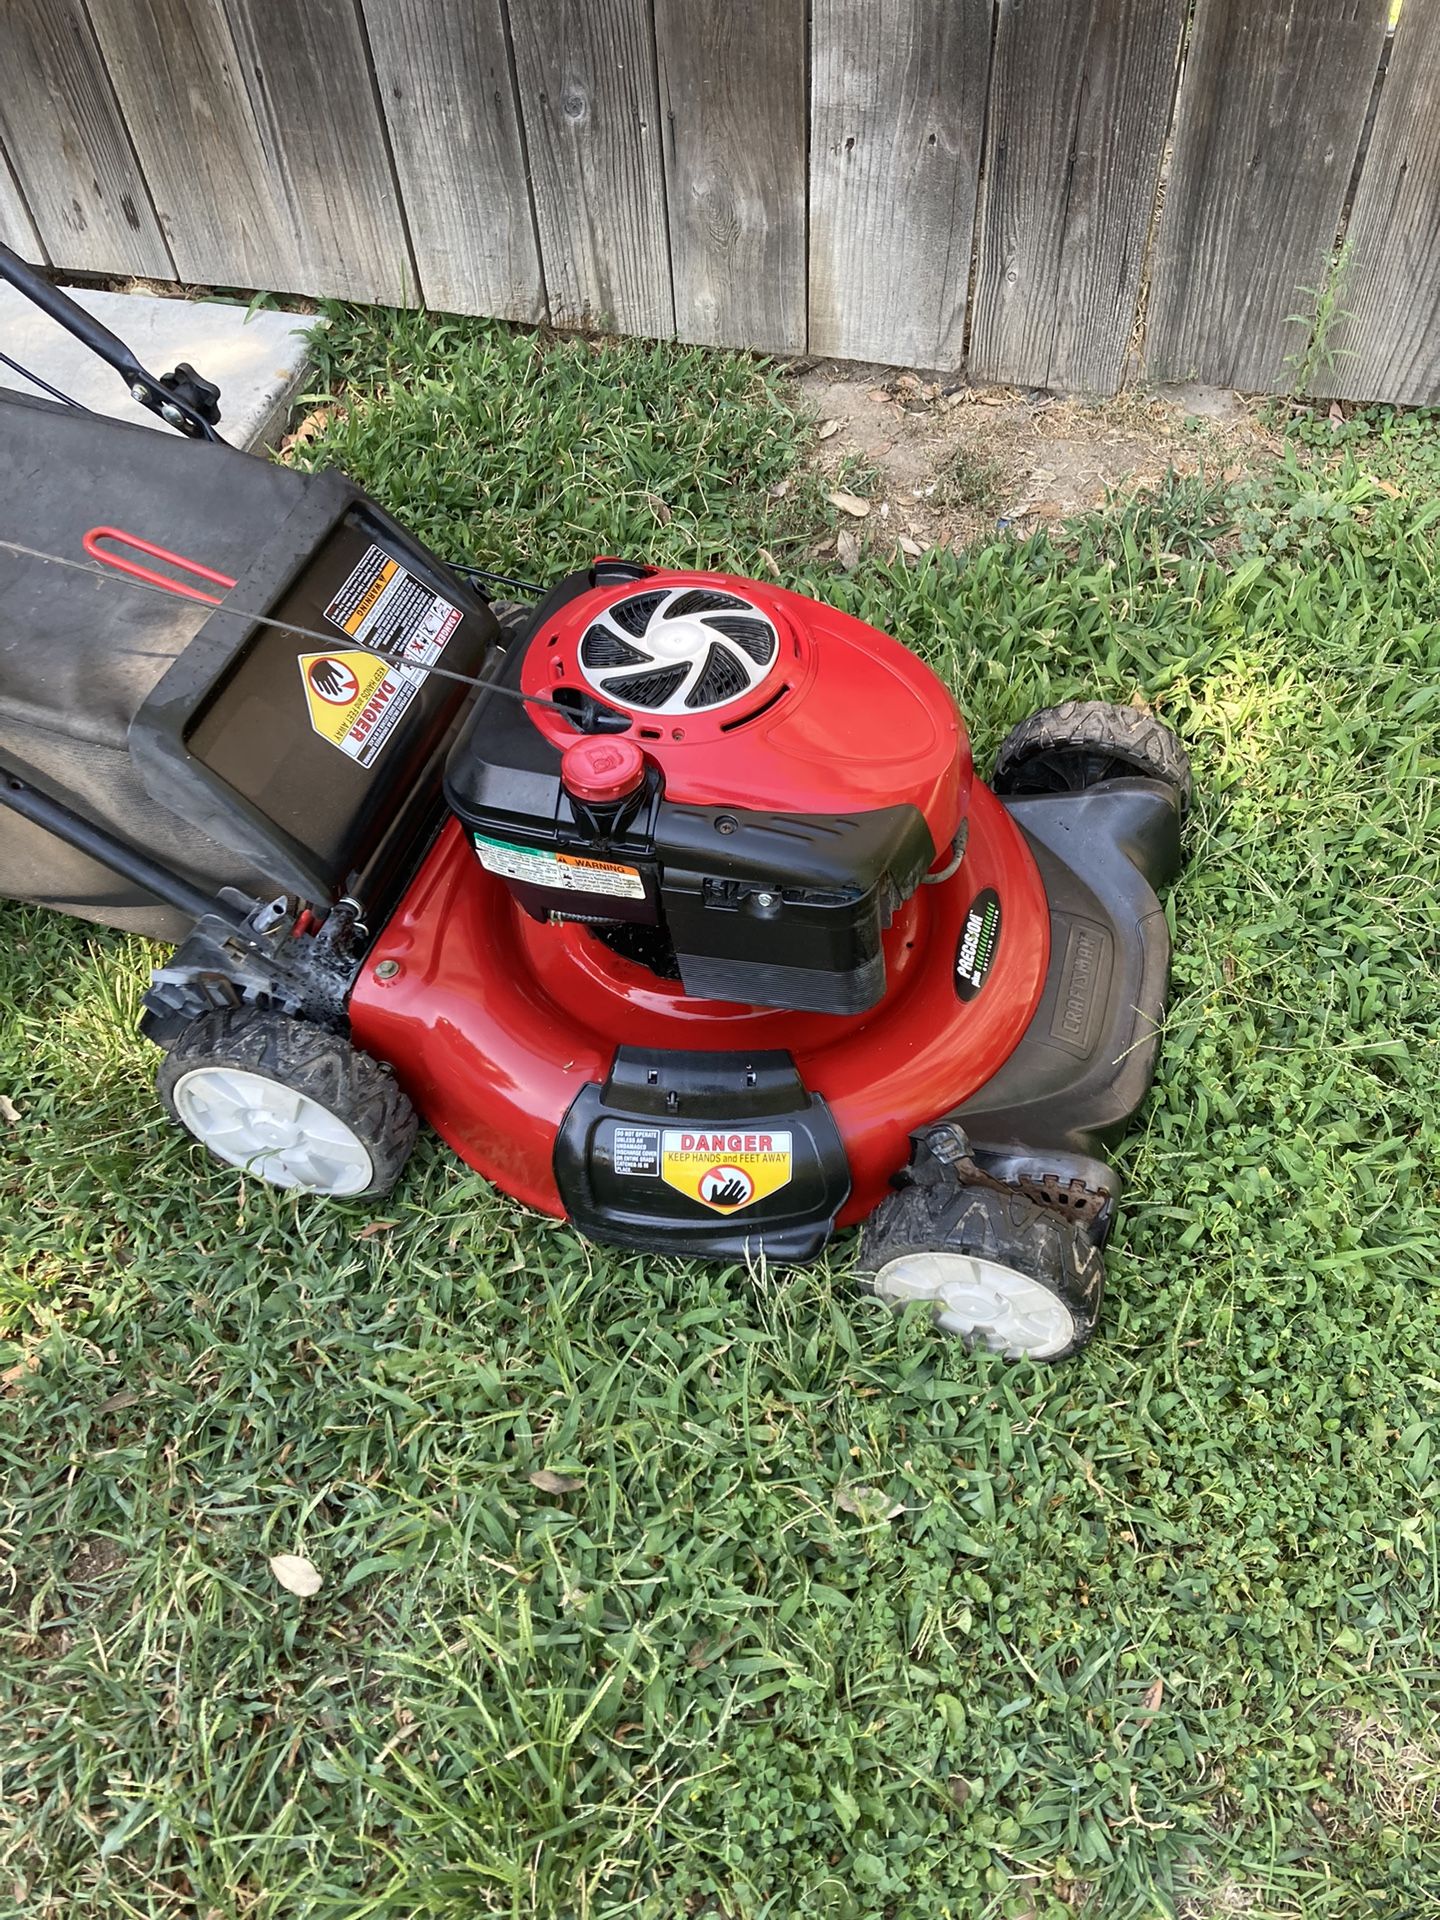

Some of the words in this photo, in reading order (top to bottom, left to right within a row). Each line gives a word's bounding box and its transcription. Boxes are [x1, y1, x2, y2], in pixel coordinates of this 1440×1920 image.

[355, 581, 382, 617] WARNING
[434, 616, 457, 645] DANGER
[372, 665, 386, 682] KEEP
[360, 679, 377, 700] HANDS
[348, 678, 397, 743] DANGER
[353, 697, 365, 709] and
[344, 706, 359, 723] FEET
[332, 720, 349, 741] AWAY
[575, 859, 625, 873] WARNING
[956, 913, 983, 978] PRECISION
[970, 969, 981, 988] plus
[1062, 934, 1094, 1034] CRAFTSMAN
[681, 1134, 773, 1151] DANGER
[668, 1153, 690, 1162] KEEP
[692, 1153, 720, 1163] HANDS
[722, 1155, 738, 1163] and
[739, 1154, 760, 1163] FEET
[762, 1154, 787, 1163] AWAY
